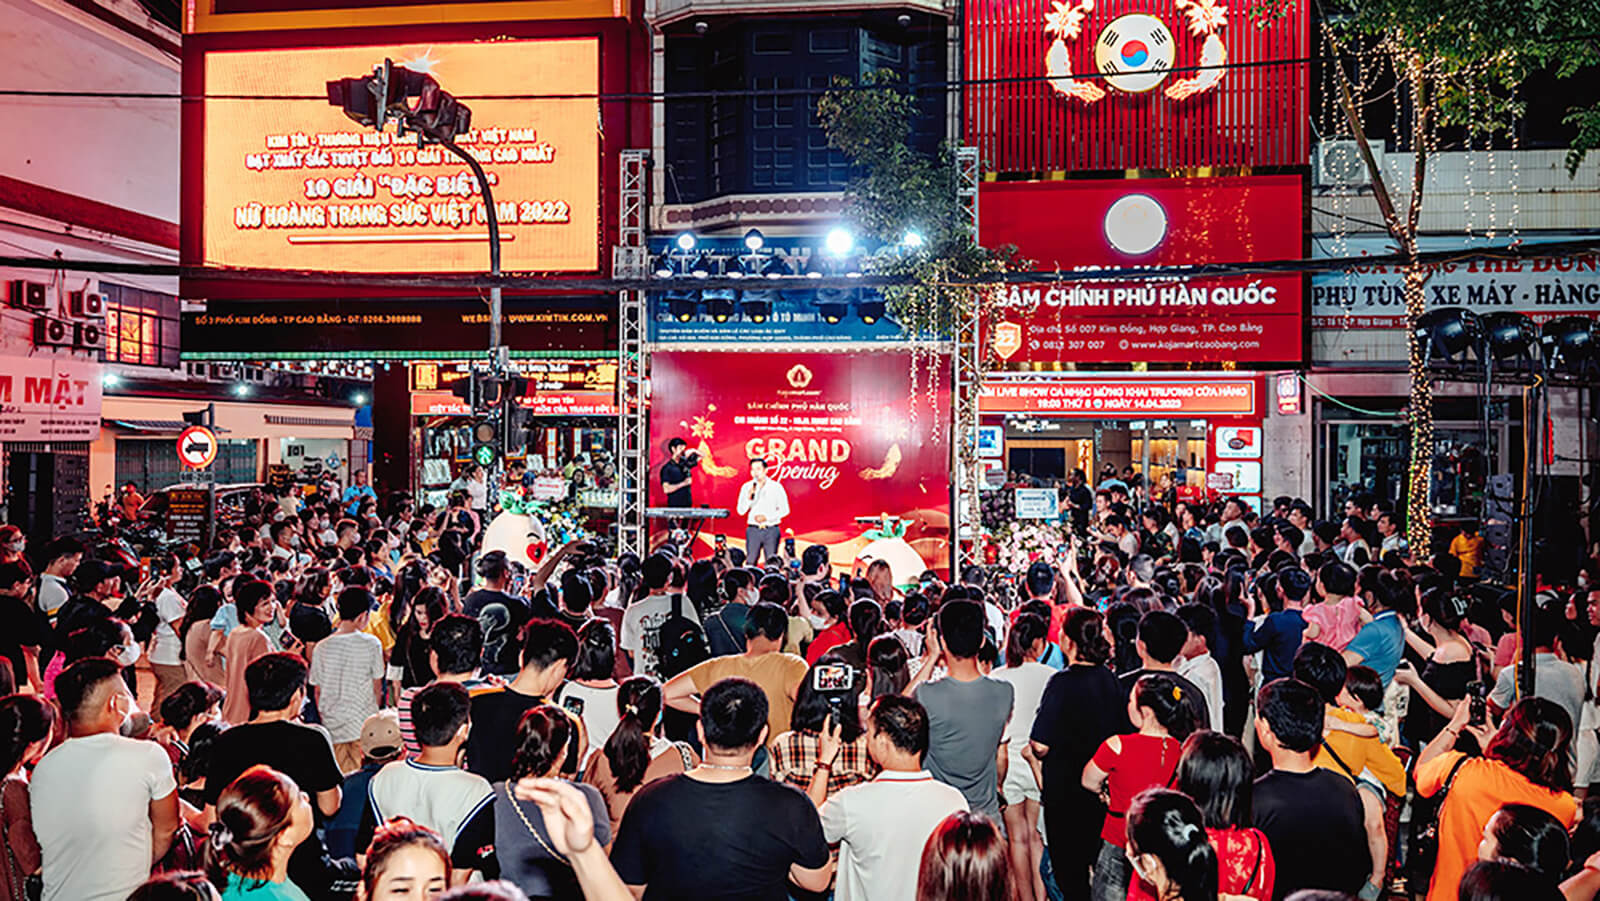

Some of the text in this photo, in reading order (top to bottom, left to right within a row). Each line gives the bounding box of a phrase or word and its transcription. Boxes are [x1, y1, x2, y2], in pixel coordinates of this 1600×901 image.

[480, 128, 507, 145] VIỆT
[508, 128, 535, 143] NAM
[400, 150, 415, 165] 10
[493, 148, 518, 163] CAO
[304, 178, 330, 198] 10
[333, 172, 375, 198] GIẢI
[235, 201, 263, 227] NỮ
[264, 200, 326, 227] HOÀNG
[328, 204, 388, 226] TRANG
[389, 198, 428, 225] SỨC
[430, 199, 473, 229] VIỆT
[519, 201, 569, 224] 2022
[995, 279, 1278, 307] SÂM CHÍNH PHỦ HÀN QUỐC
[1312, 285, 1358, 311] PHỤ
[1362, 279, 1410, 306] TÙN
[1431, 285, 1462, 305] XE
[1466, 278, 1518, 305] MÁY
[1534, 277, 1600, 305] HÀNG
[235, 315, 251, 325] KIM
[295, 315, 315, 325] CAO
[1079, 324, 1097, 333] 007
[1099, 324, 1117, 333] Kim
[1170, 323, 1199, 335] Giang,
[1202, 323, 1216, 333] TP.
[1218, 323, 1237, 333] Cao
[1239, 321, 1264, 335] Bằng
[1087, 340, 1105, 350] 007
[1131, 339, 1260, 351] www.kojamartcaobang.com
[24, 372, 89, 410] MẶT
[996, 387, 1018, 397] LIVE
[1019, 386, 1049, 397] SHOW
[1050, 386, 1064, 397] CA
[1125, 386, 1149, 397] KHAI
[1218, 385, 1248, 397] HÀNG
[745, 437, 851, 463] GRAND
